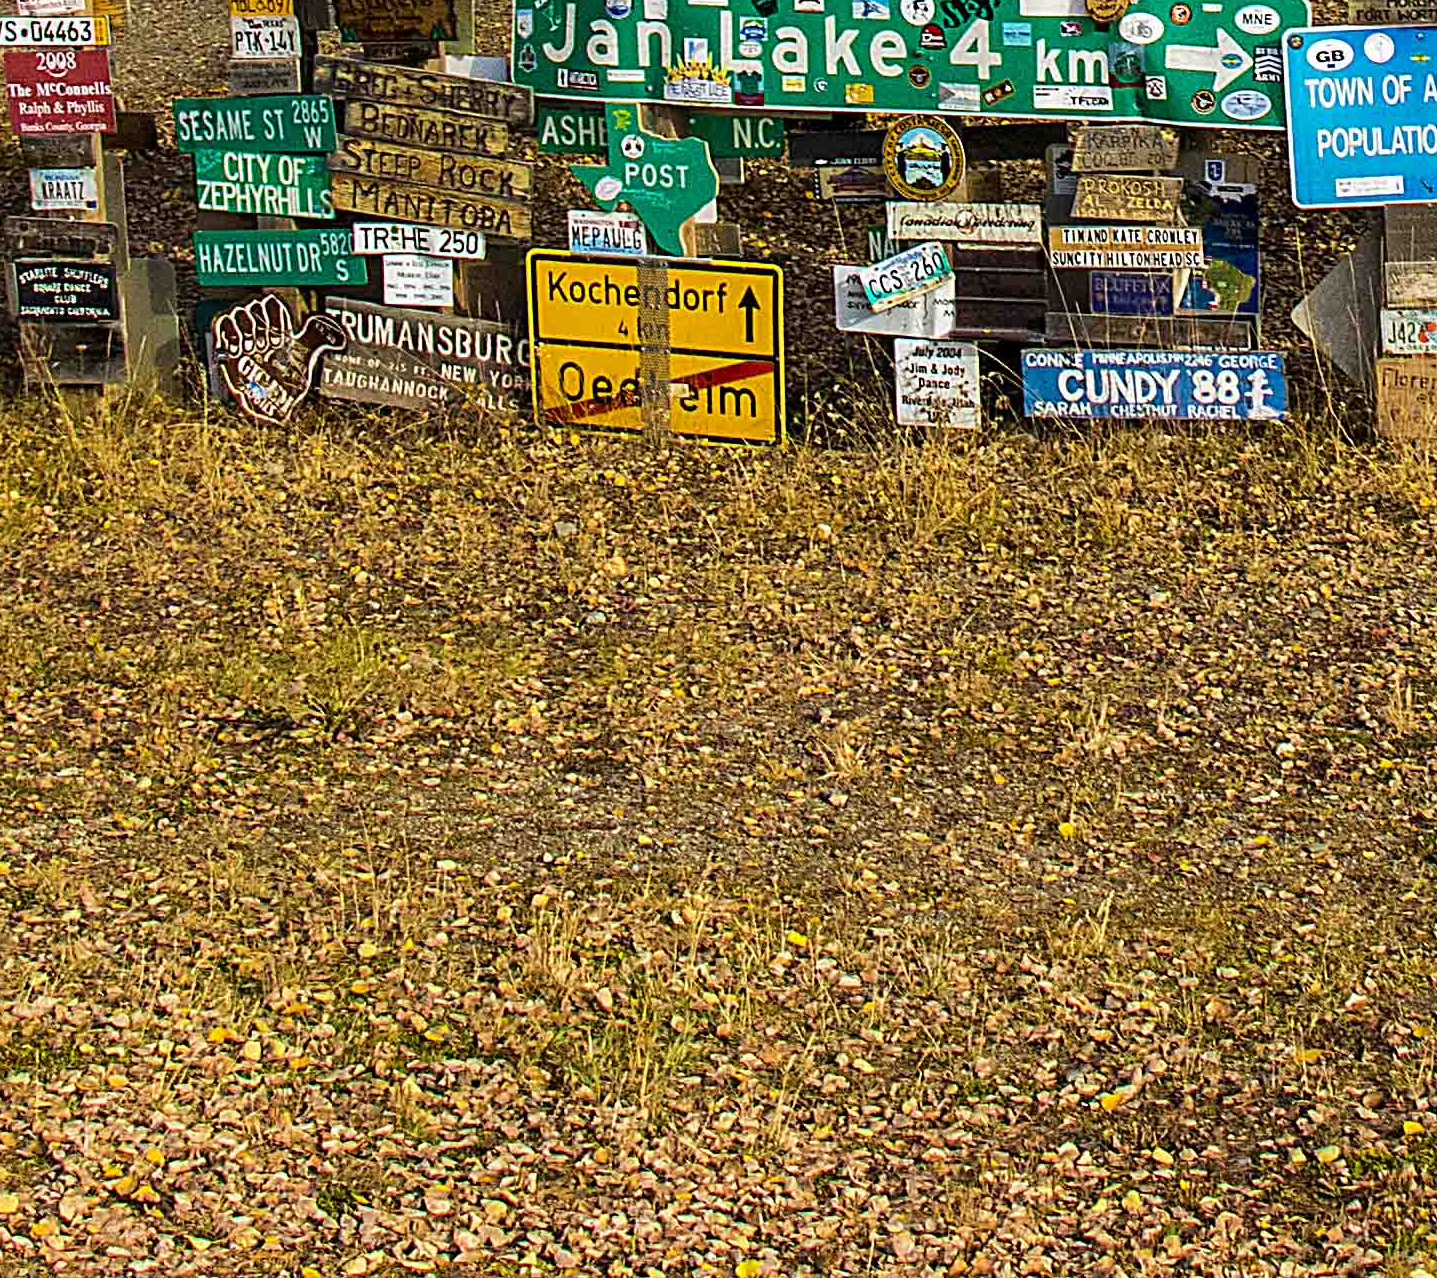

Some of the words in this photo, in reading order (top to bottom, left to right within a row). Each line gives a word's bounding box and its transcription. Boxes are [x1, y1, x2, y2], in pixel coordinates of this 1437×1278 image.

[542, 3, 670, 67] Jan
[721, 10, 908, 76] Lake
[949, 21, 1002, 80] 4
[1036, 40, 1110, 84] km
[36, 51, 77, 71] 2008
[1305, 77, 1374, 108] TOWN
[1382, 79, 1413, 104] OF
[179, 111, 253, 142] SESAME
[264, 113, 285, 139] ST
[292, 100, 330, 124] 2865
[224, 153, 271, 181] CITY
[279, 154, 306, 180] OF
[624, 163, 689, 189] POST
[198, 180, 332, 217] ZEPHYRHILLS
[199, 243, 296, 276] HAZELNUT
[298, 242, 322, 271] DR
[1034, 401, 1092, 417] SARAH
[1111, 404, 1177, 416] CHESTNUT
[1187, 404, 1237, 417] RACHEL
